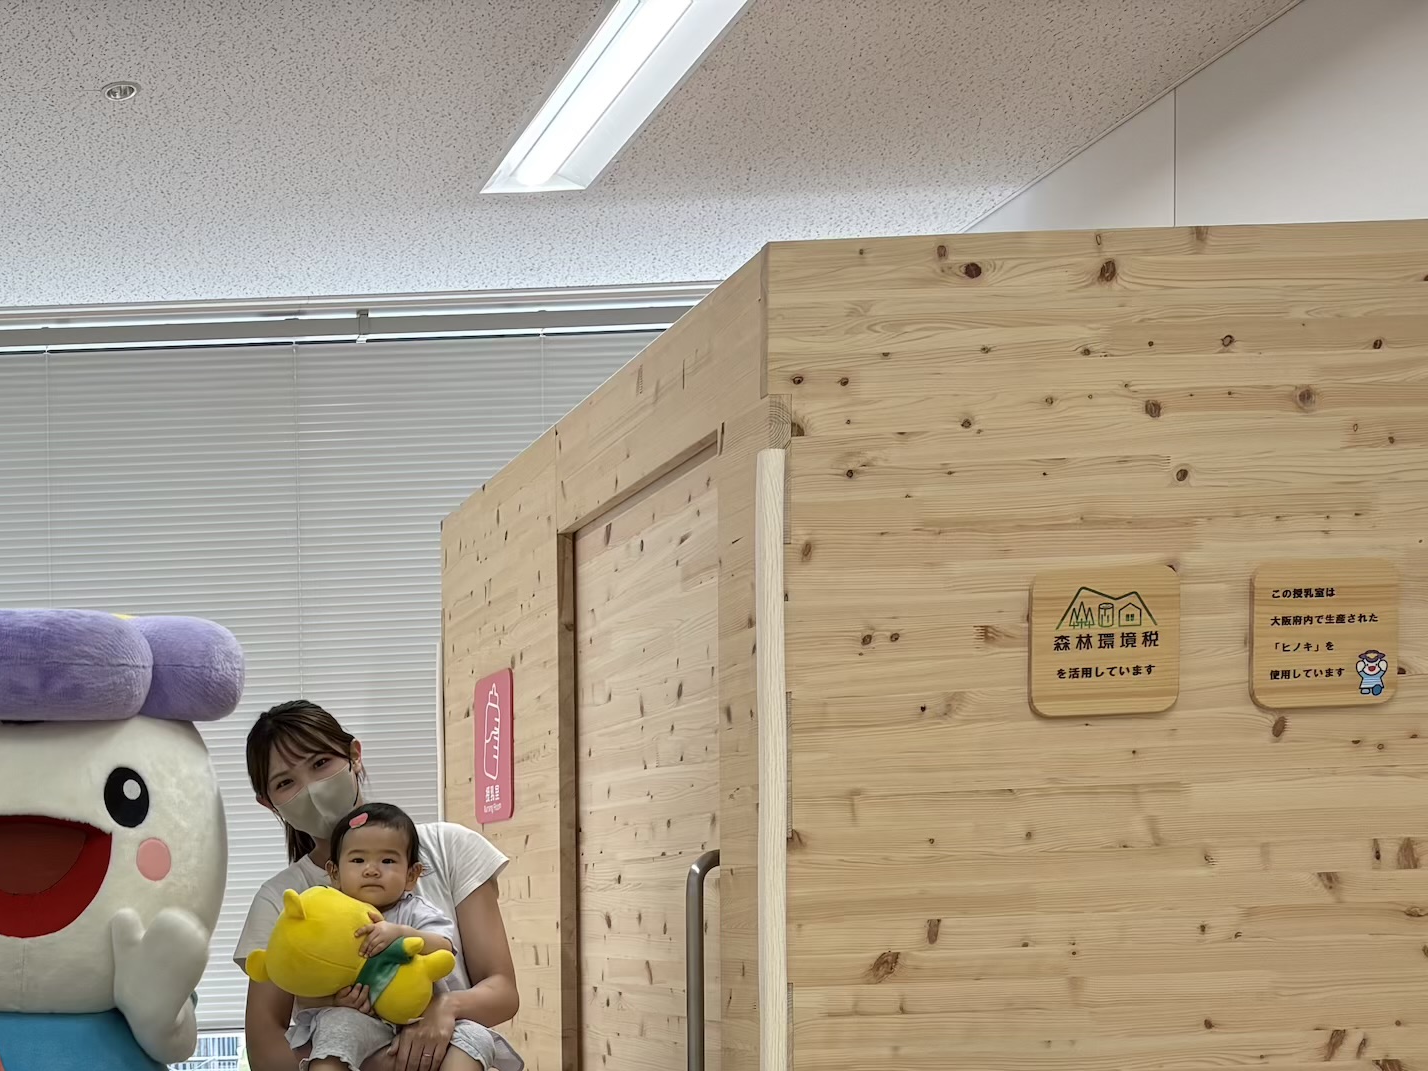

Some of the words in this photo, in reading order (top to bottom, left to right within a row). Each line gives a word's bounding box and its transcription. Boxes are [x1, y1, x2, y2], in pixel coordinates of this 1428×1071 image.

[1271, 587, 1336, 599] この授乳室は
[1270, 613, 1378, 627] 大阪府内で生産された
[1053, 630, 1160, 652] 森林環境税
[1274, 641, 1335, 652] 「ヒノキ」を
[1056, 664, 1156, 680] を活用しています
[1270, 667, 1345, 681] 使用しています
